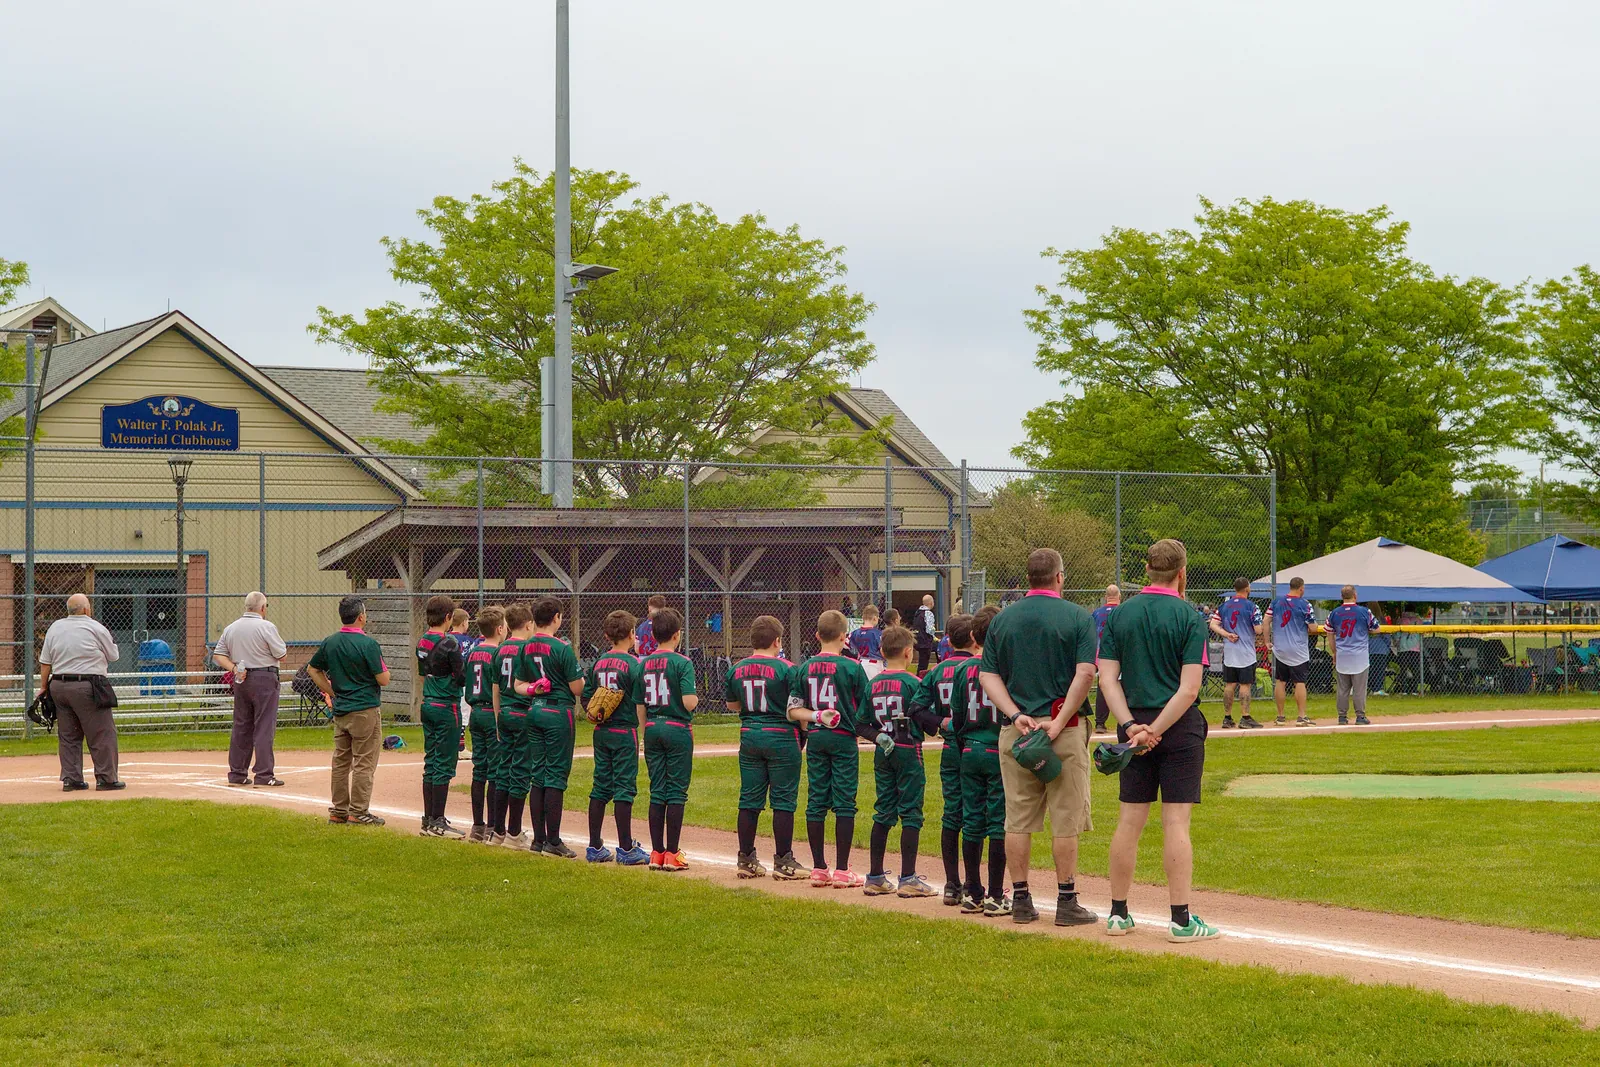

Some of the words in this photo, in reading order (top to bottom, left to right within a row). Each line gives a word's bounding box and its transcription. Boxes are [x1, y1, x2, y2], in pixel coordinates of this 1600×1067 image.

[117, 419, 158, 430] Walter
[161, 420, 171, 430] F.
[175, 420, 207, 431] Polak
[210, 420, 225, 432] Jr.
[110, 433, 167, 445] Memorial
[171, 434, 232, 446] Clubhouse
[1229, 610, 1240, 630] 5
[1280, 609, 1292, 628] 9
[1339, 618, 1357, 638] 51
[501, 657, 513, 688] 9
[808, 662, 837, 675] MYERS
[472, 664, 483, 695] 3
[643, 672, 670, 706] 34
[872, 679, 902, 694] COTTON
[742, 679, 767, 713] 17
[807, 677, 838, 710] 14
